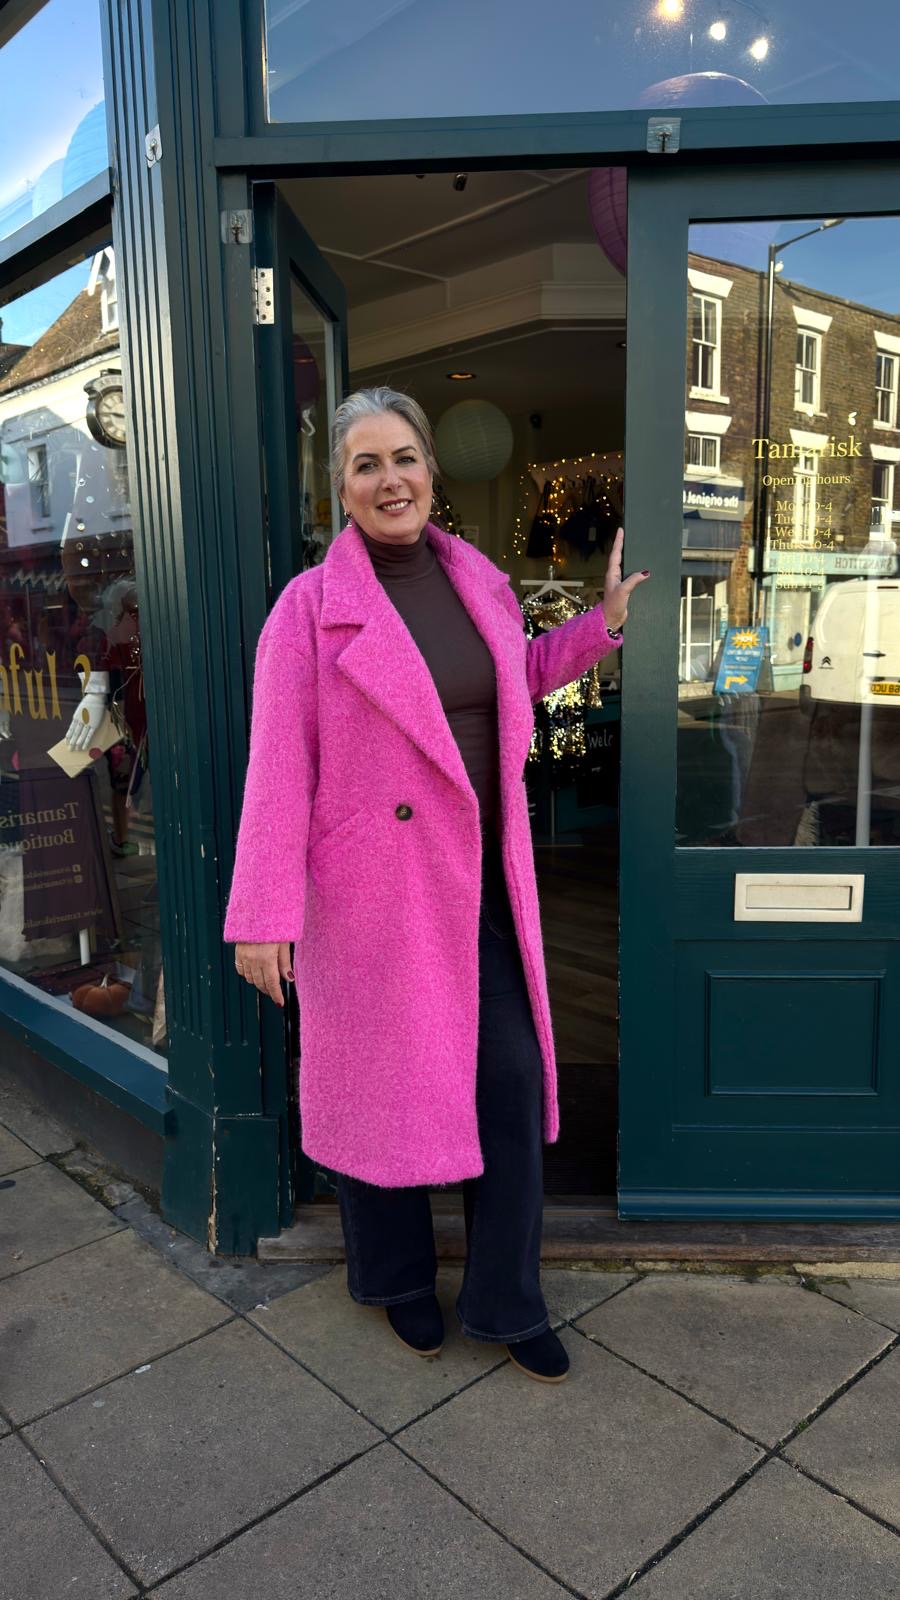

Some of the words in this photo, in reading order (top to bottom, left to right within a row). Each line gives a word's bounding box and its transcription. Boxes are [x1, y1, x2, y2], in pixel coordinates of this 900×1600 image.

[752, 436, 862, 459] Tamarisk
[763, 474, 812, 489] Opening
[817, 473, 850, 485] hours
[776, 501, 804, 512] Mo
[808, 502, 832, 513] 0-4
[809, 515, 832, 526] 0-4
[775, 527, 803, 537] We
[808, 528, 831, 538] 0-4
[810, 541, 834, 551] 0-4
